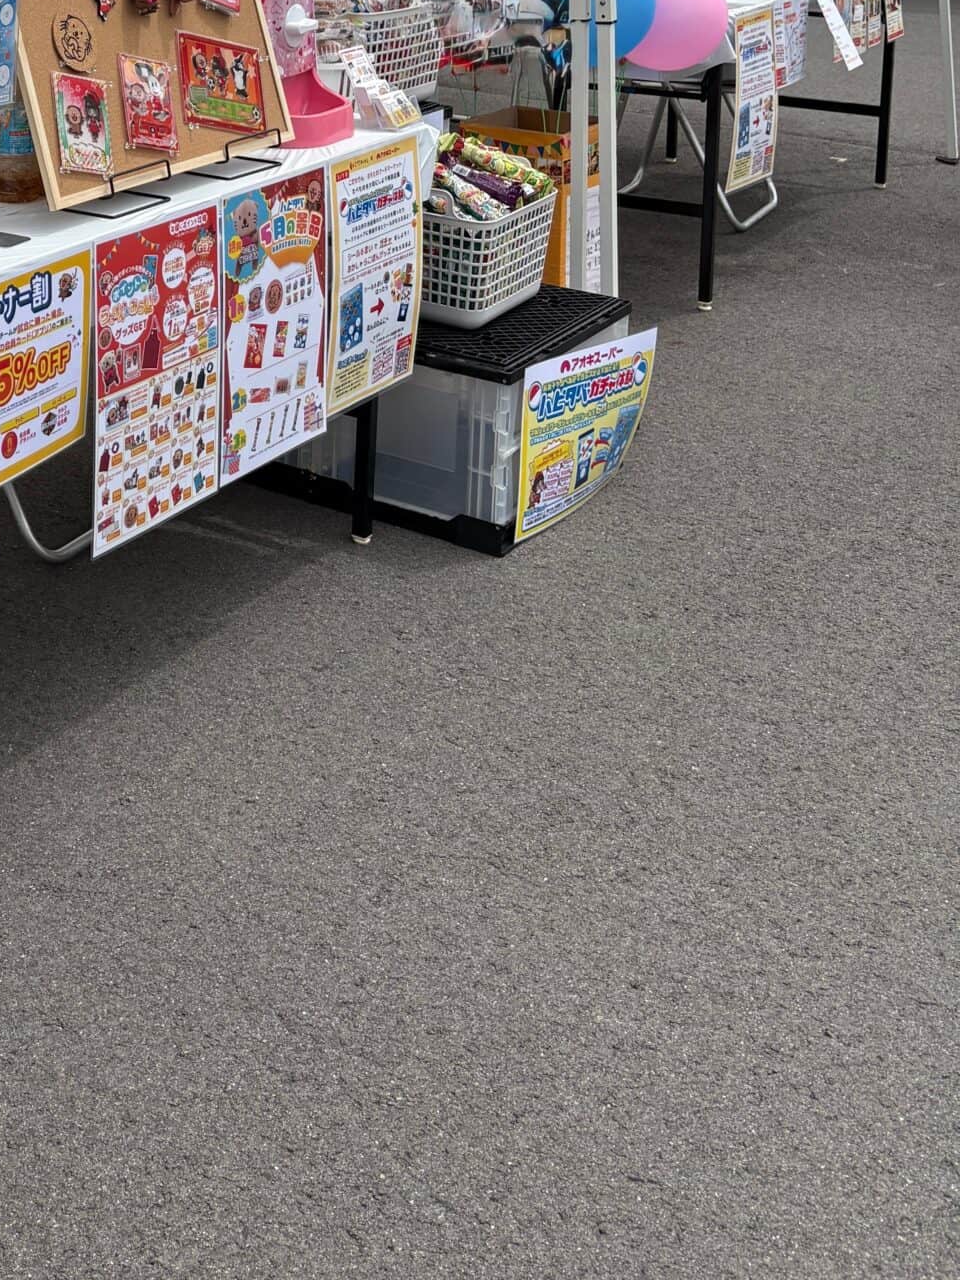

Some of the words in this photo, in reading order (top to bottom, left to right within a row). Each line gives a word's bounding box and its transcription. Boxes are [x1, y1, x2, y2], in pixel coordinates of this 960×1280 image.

[572, 347, 623, 371] アオキスーパー
